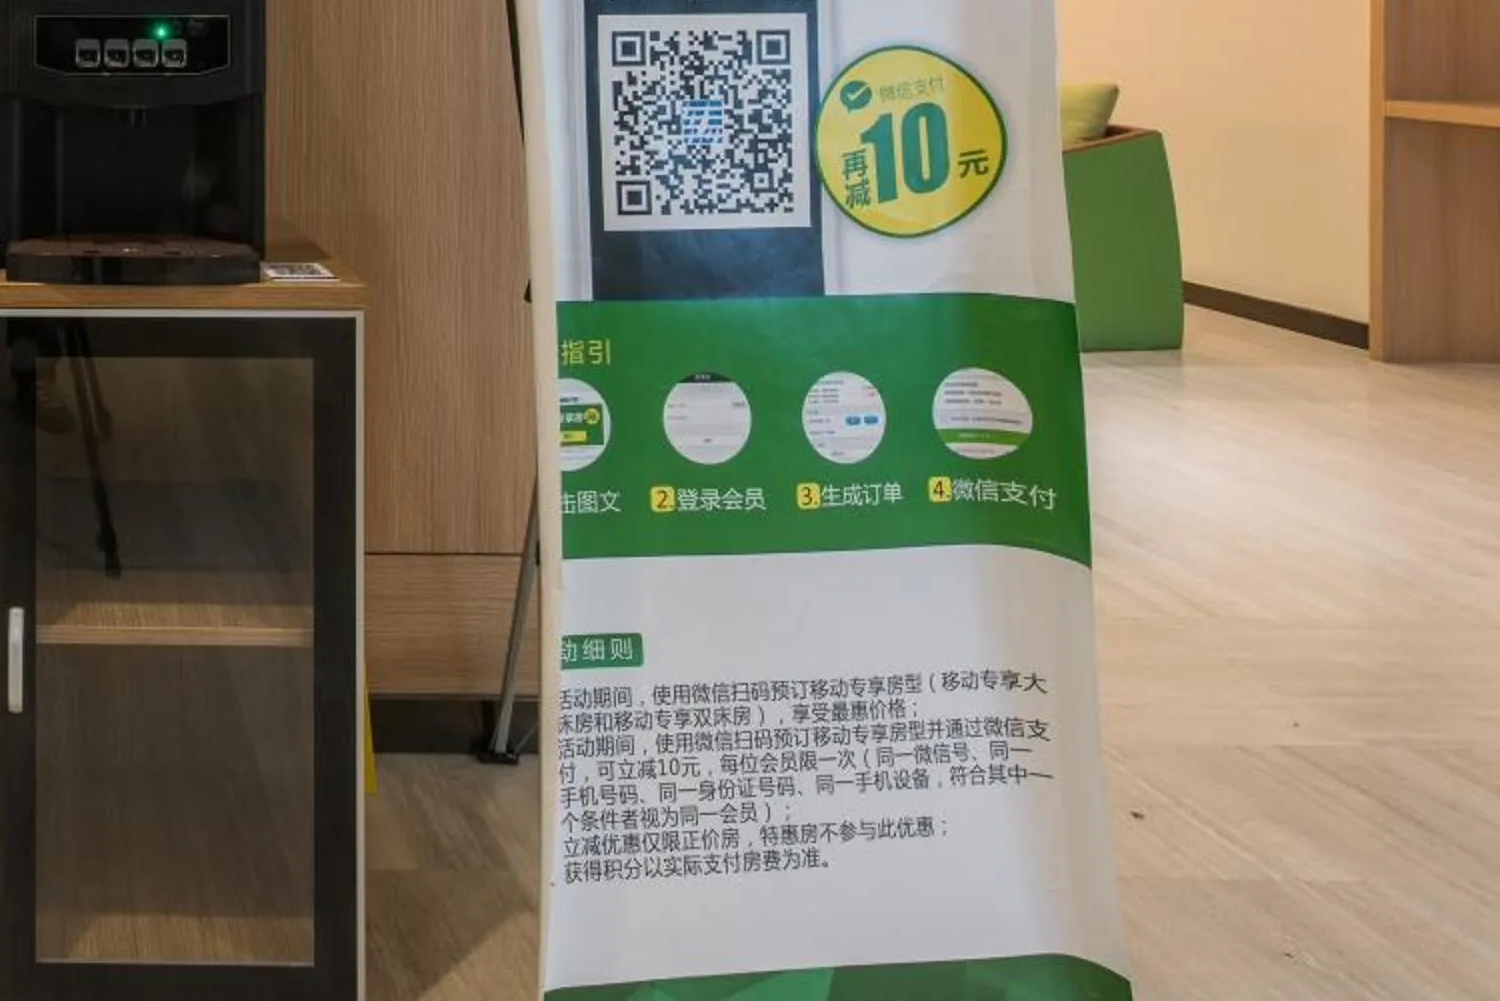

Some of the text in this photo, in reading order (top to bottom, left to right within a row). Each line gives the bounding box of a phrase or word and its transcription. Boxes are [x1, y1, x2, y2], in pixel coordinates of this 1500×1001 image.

[879, 77, 945, 101] 微信支付
[860, 101, 950, 204] 10
[957, 148, 990, 179] 元
[560, 339, 612, 366] 指引
[677, 487, 767, 512] 登录会员
[821, 481, 903, 507] 生成订单
[952, 479, 1057, 510] 微信支付
